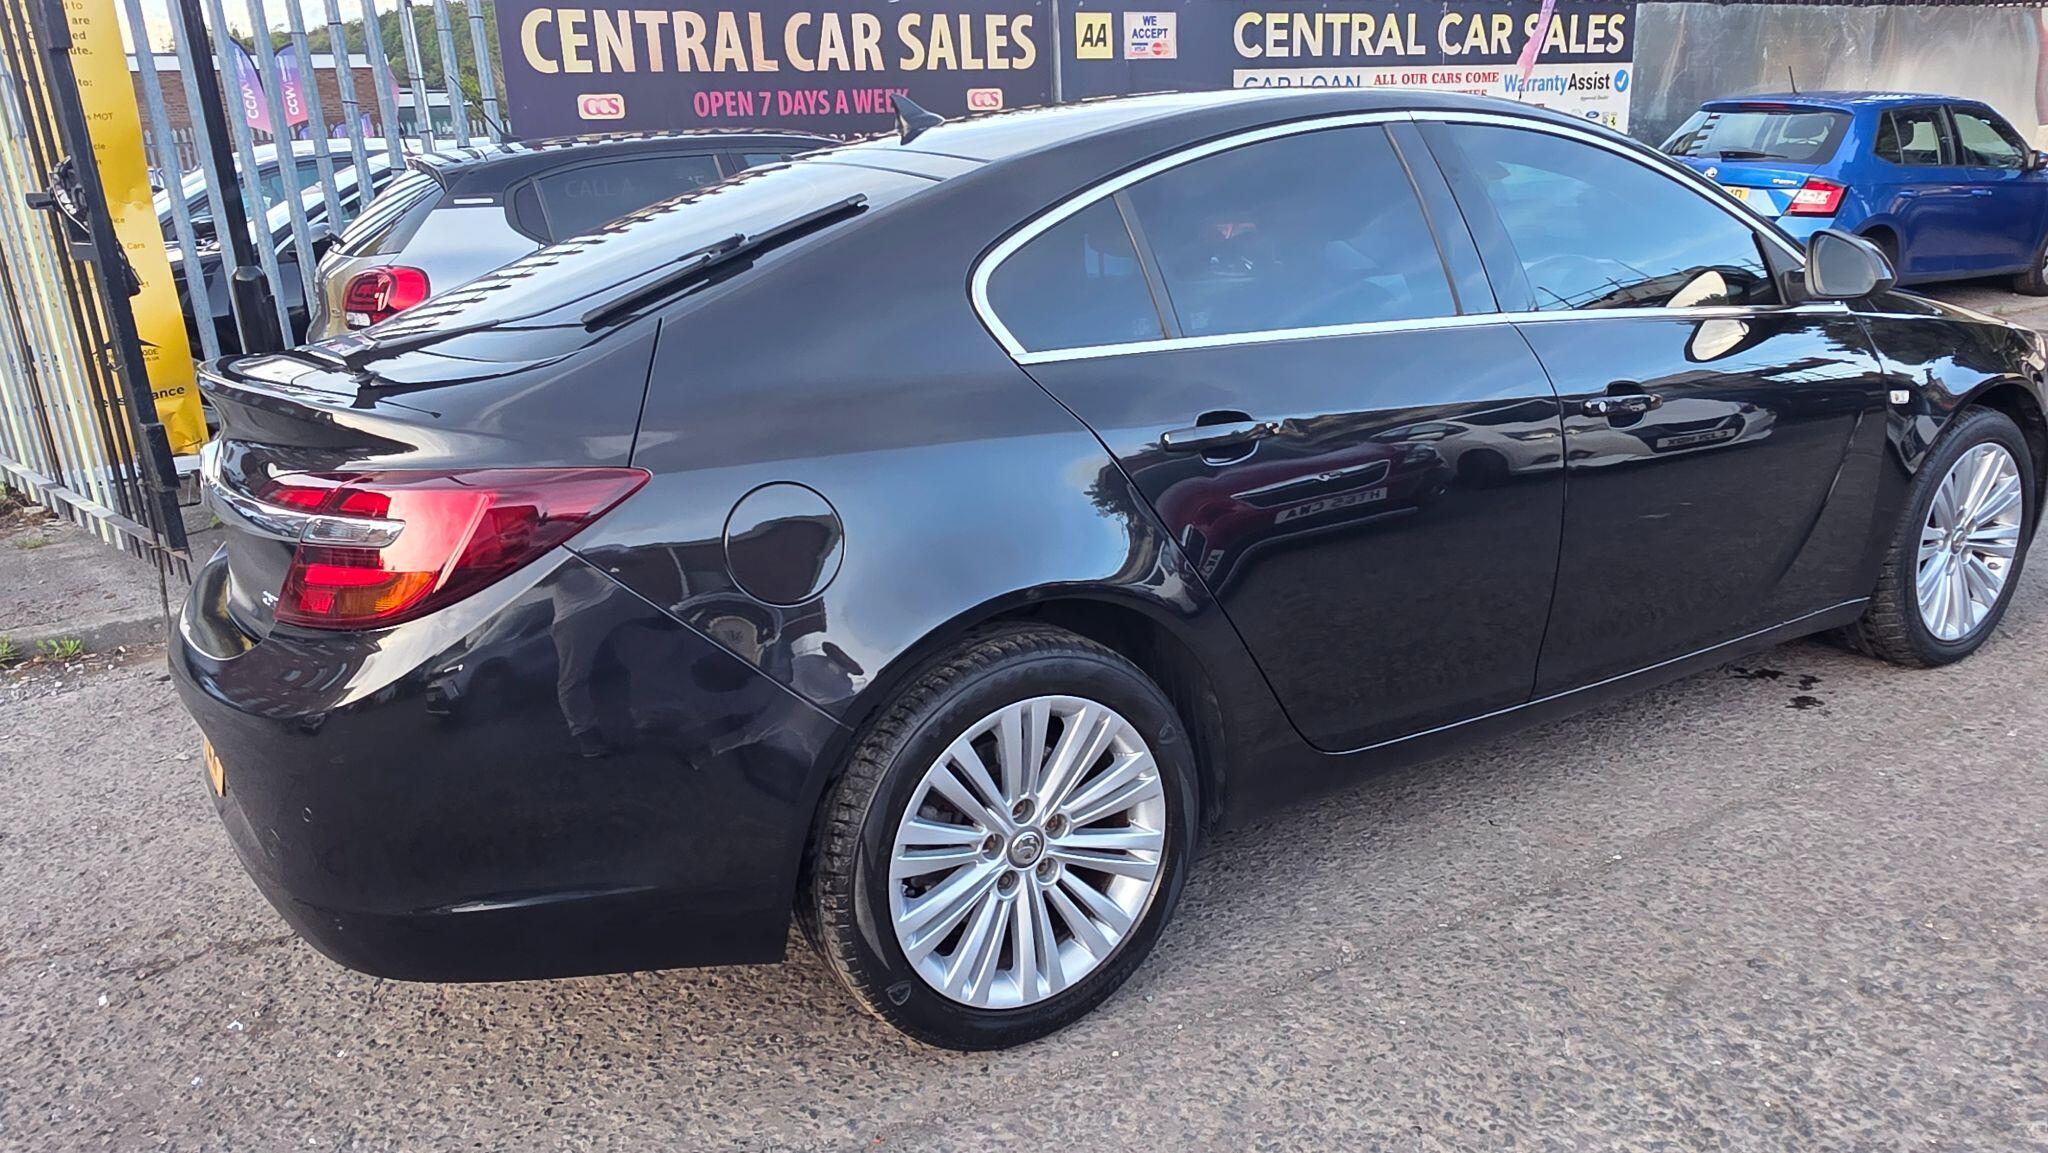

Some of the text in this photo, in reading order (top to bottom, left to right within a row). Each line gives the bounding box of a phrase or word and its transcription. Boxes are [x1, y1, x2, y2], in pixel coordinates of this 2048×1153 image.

[1142, 15, 1157, 26] WE
[519, 8, 1037, 74] CENTRAL CAR SALES
[1081, 23, 1107, 47] AA
[1131, 28, 1168, 39] ACCEPT
[1233, 11, 1427, 57] CENTRAL
[1438, 12, 1512, 56] CAR
[1373, 71, 1500, 86] ALL OUR CARS COME
[583, 97, 620, 116] CCS
[693, 91, 757, 118] OPEN
[758, 91, 771, 117] 7
[780, 90, 832, 116] DAYS
[835, 89, 850, 114] A
[971, 91, 1000, 107] CCS
[93, 112, 114, 120] MOT
[126, 242, 146, 250] Cars
